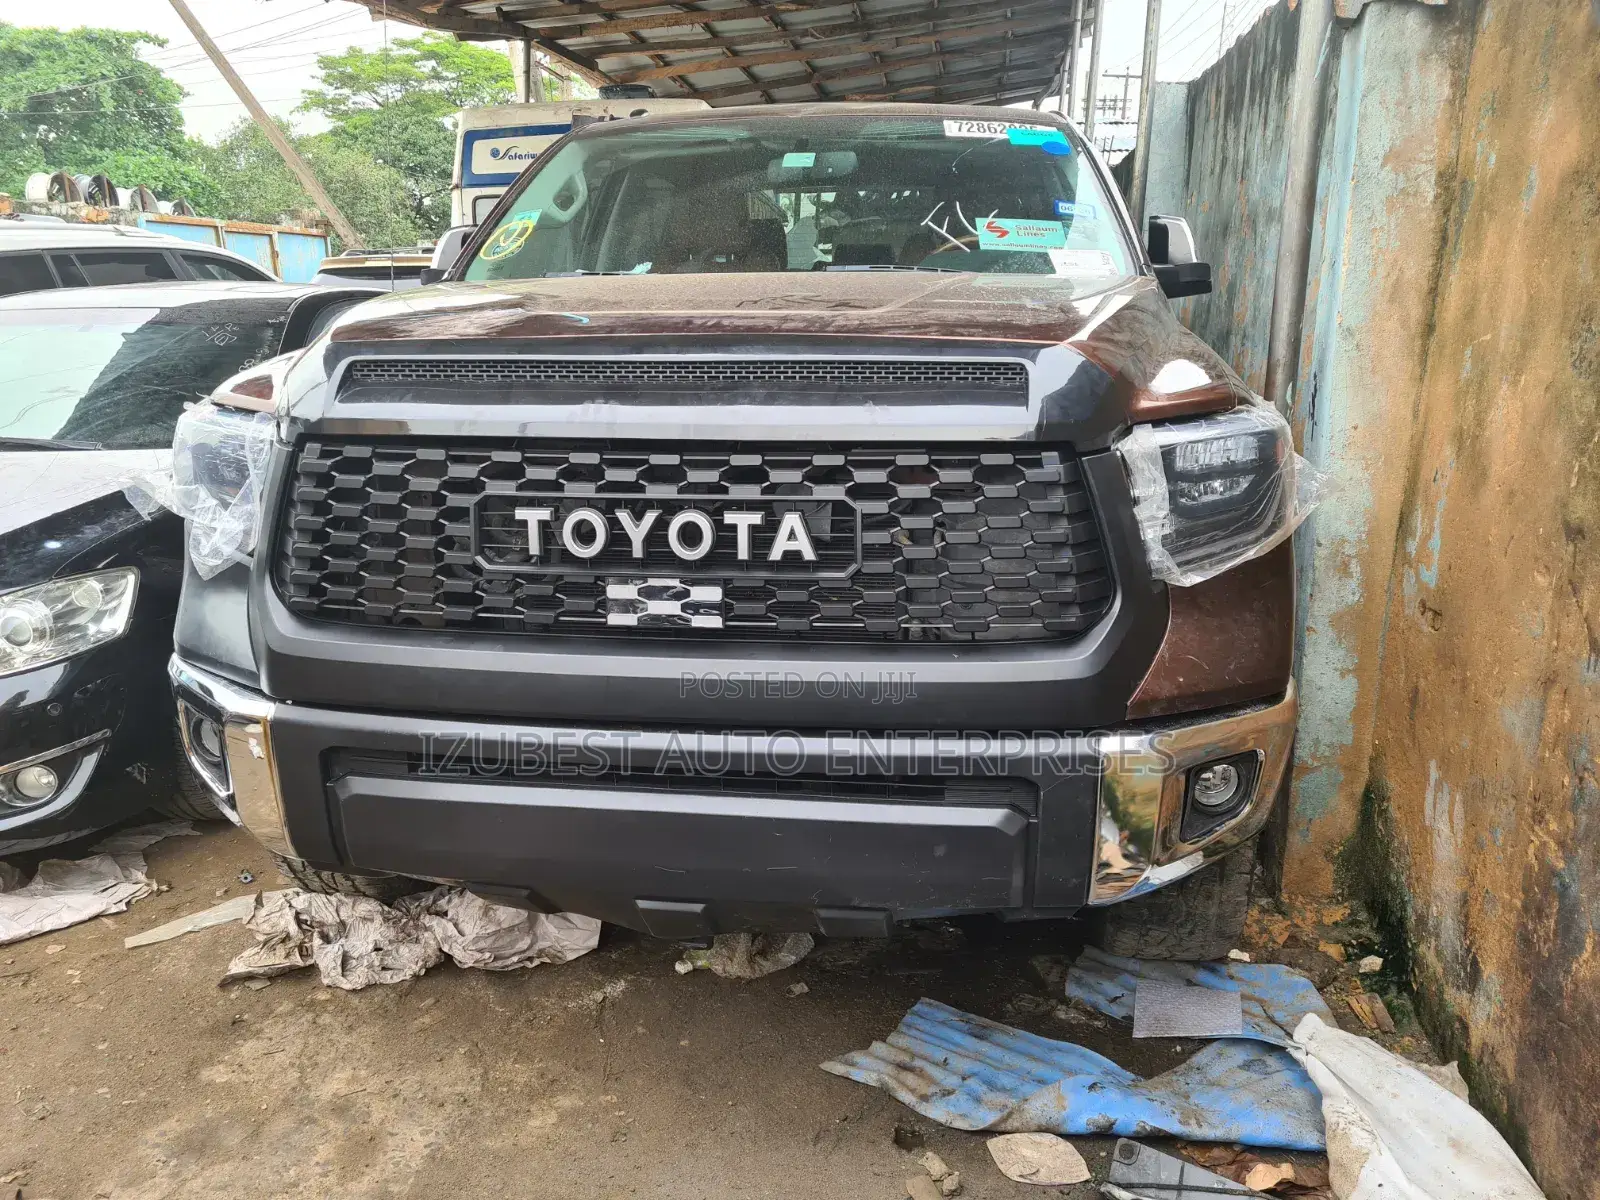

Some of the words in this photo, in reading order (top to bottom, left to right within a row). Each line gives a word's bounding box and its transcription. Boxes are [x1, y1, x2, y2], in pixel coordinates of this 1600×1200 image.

[1015, 224, 1058, 233] Sallaum
[1016, 230, 1046, 238] Lines
[514, 507, 818, 562] TOYOTA
